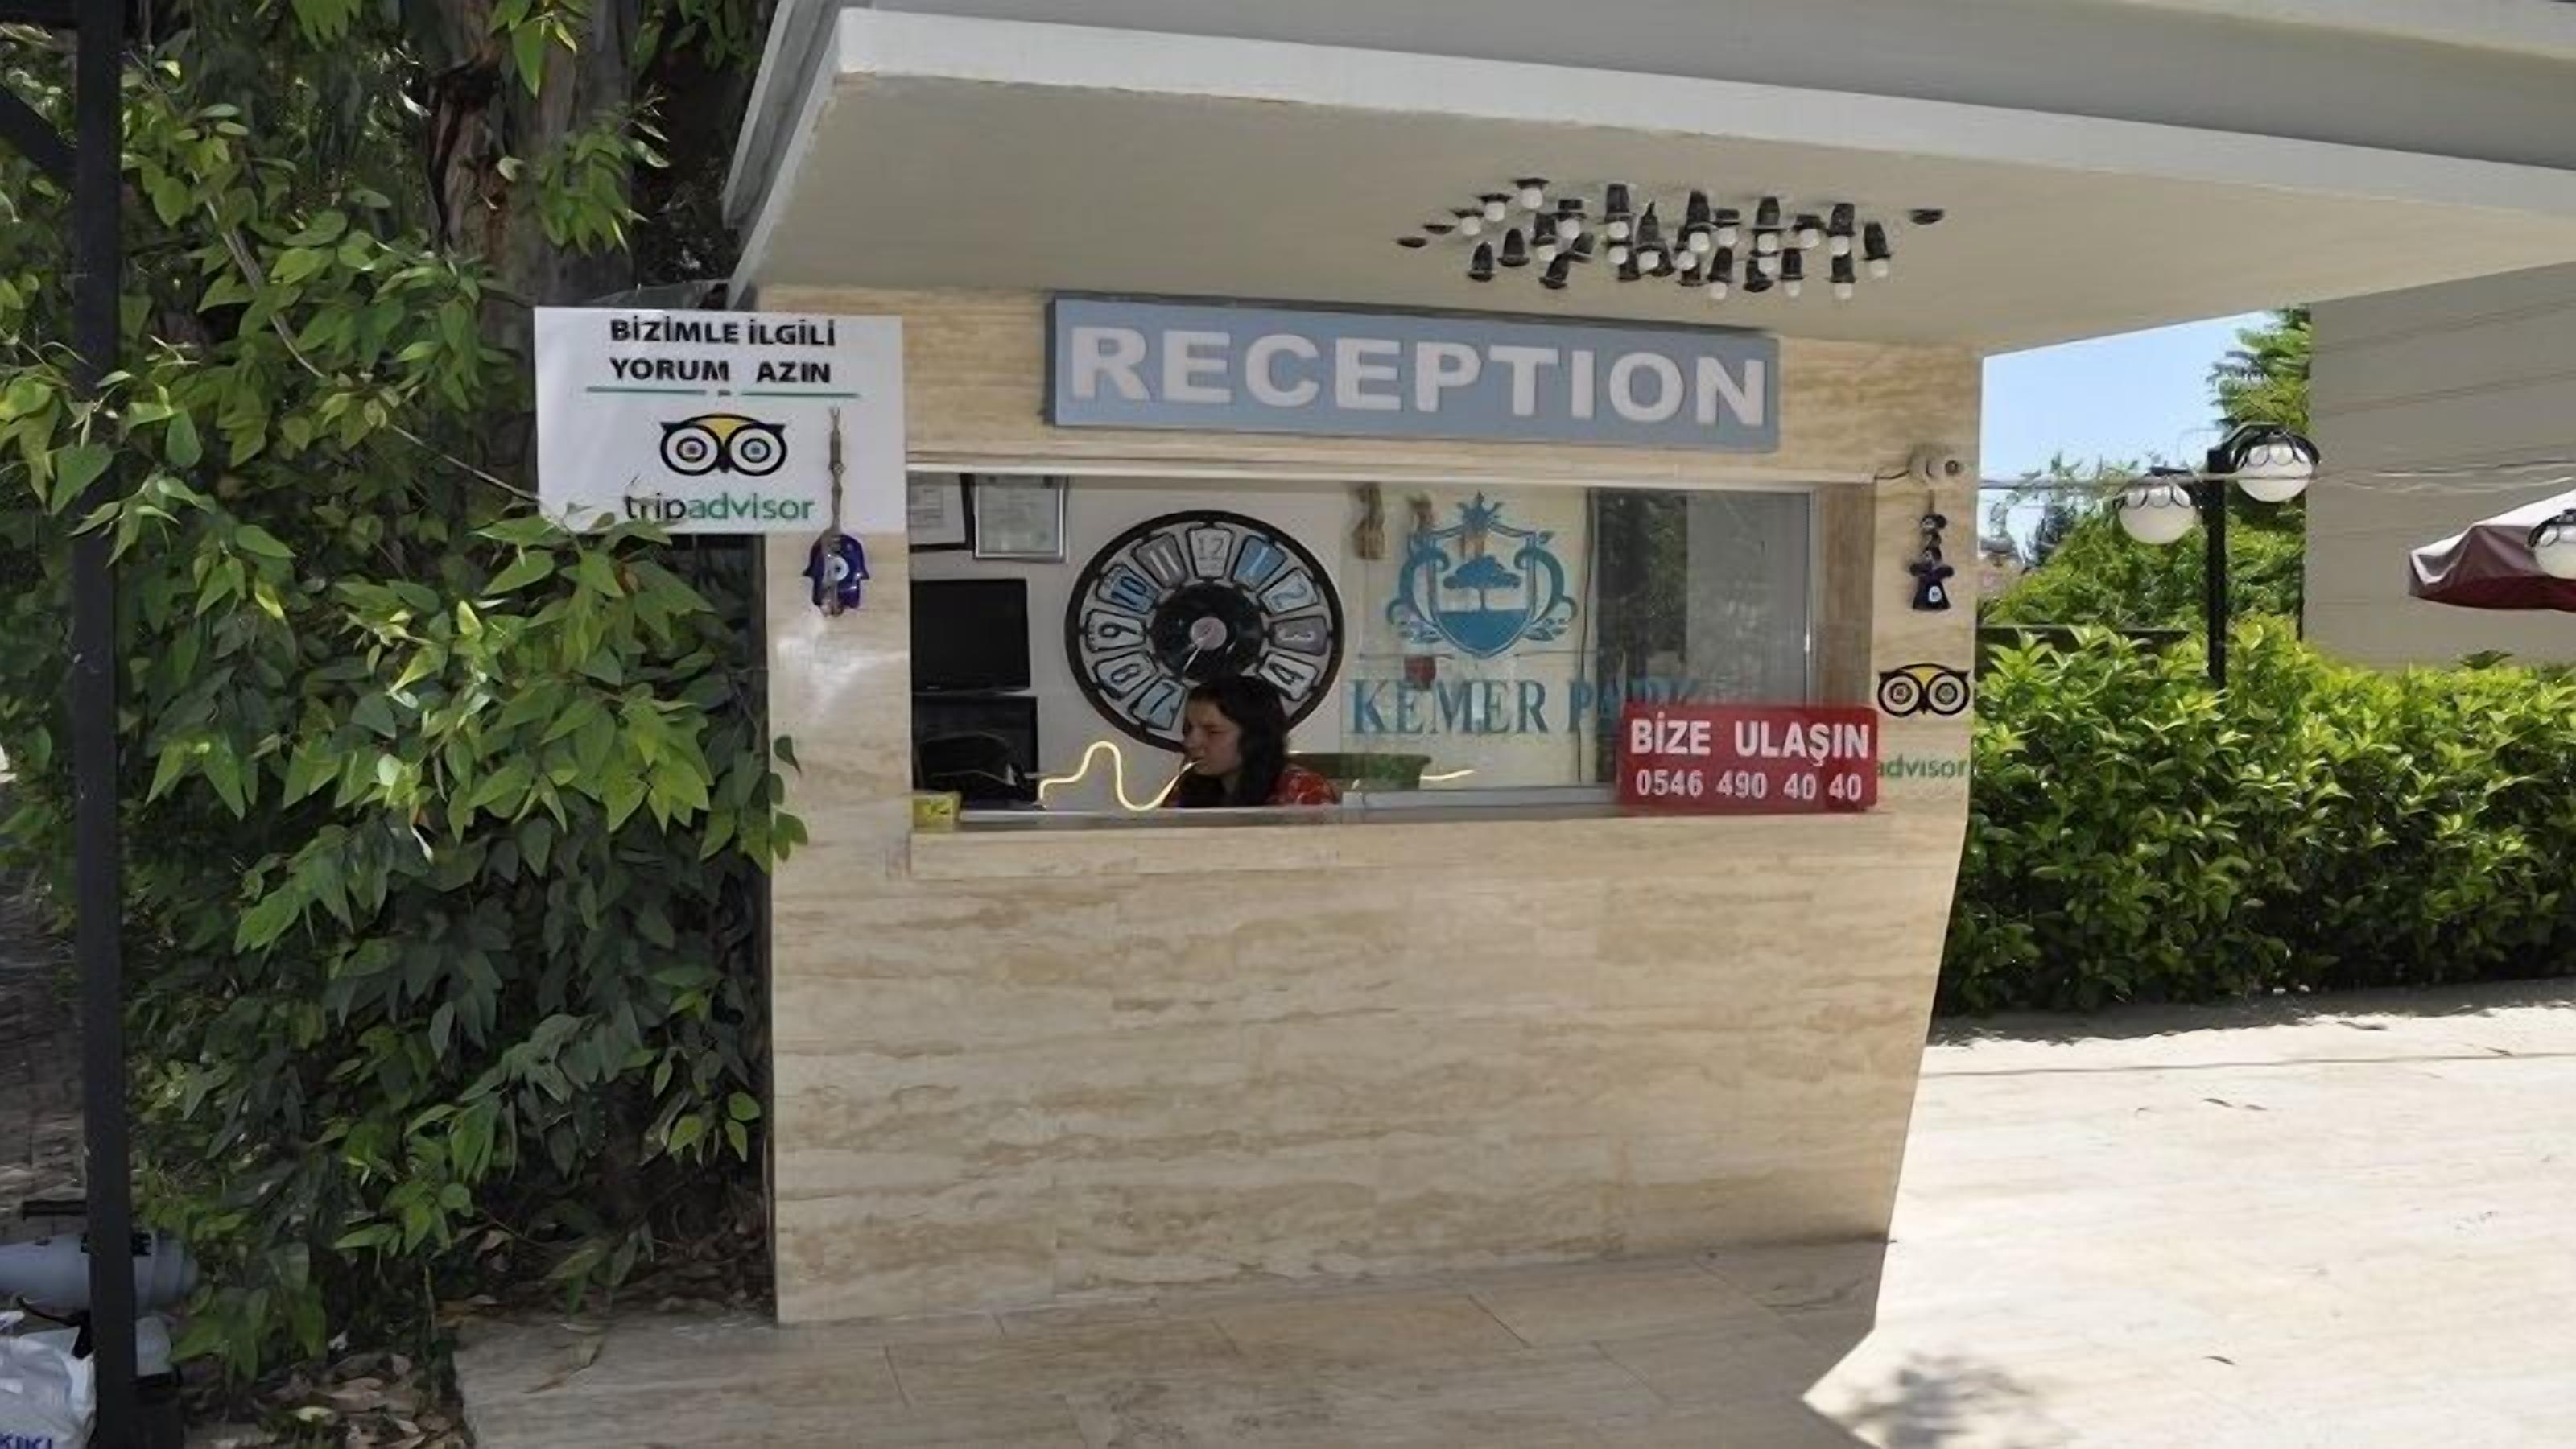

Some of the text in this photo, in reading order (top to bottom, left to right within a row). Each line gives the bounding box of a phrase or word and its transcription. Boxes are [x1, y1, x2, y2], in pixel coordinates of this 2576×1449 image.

[609, 315, 835, 346] BİZİMLE İLGİLİ
[609, 357, 730, 382] YORUM
[1071, 327, 1766, 425] RECEPTION
[624, 493, 815, 520] tripadvisor
[1352, 679, 1549, 733] KEMER
[1631, 712, 1869, 766] BİZE ULAŞIN
[1636, 769, 1862, 801] 0546 490 40 40
